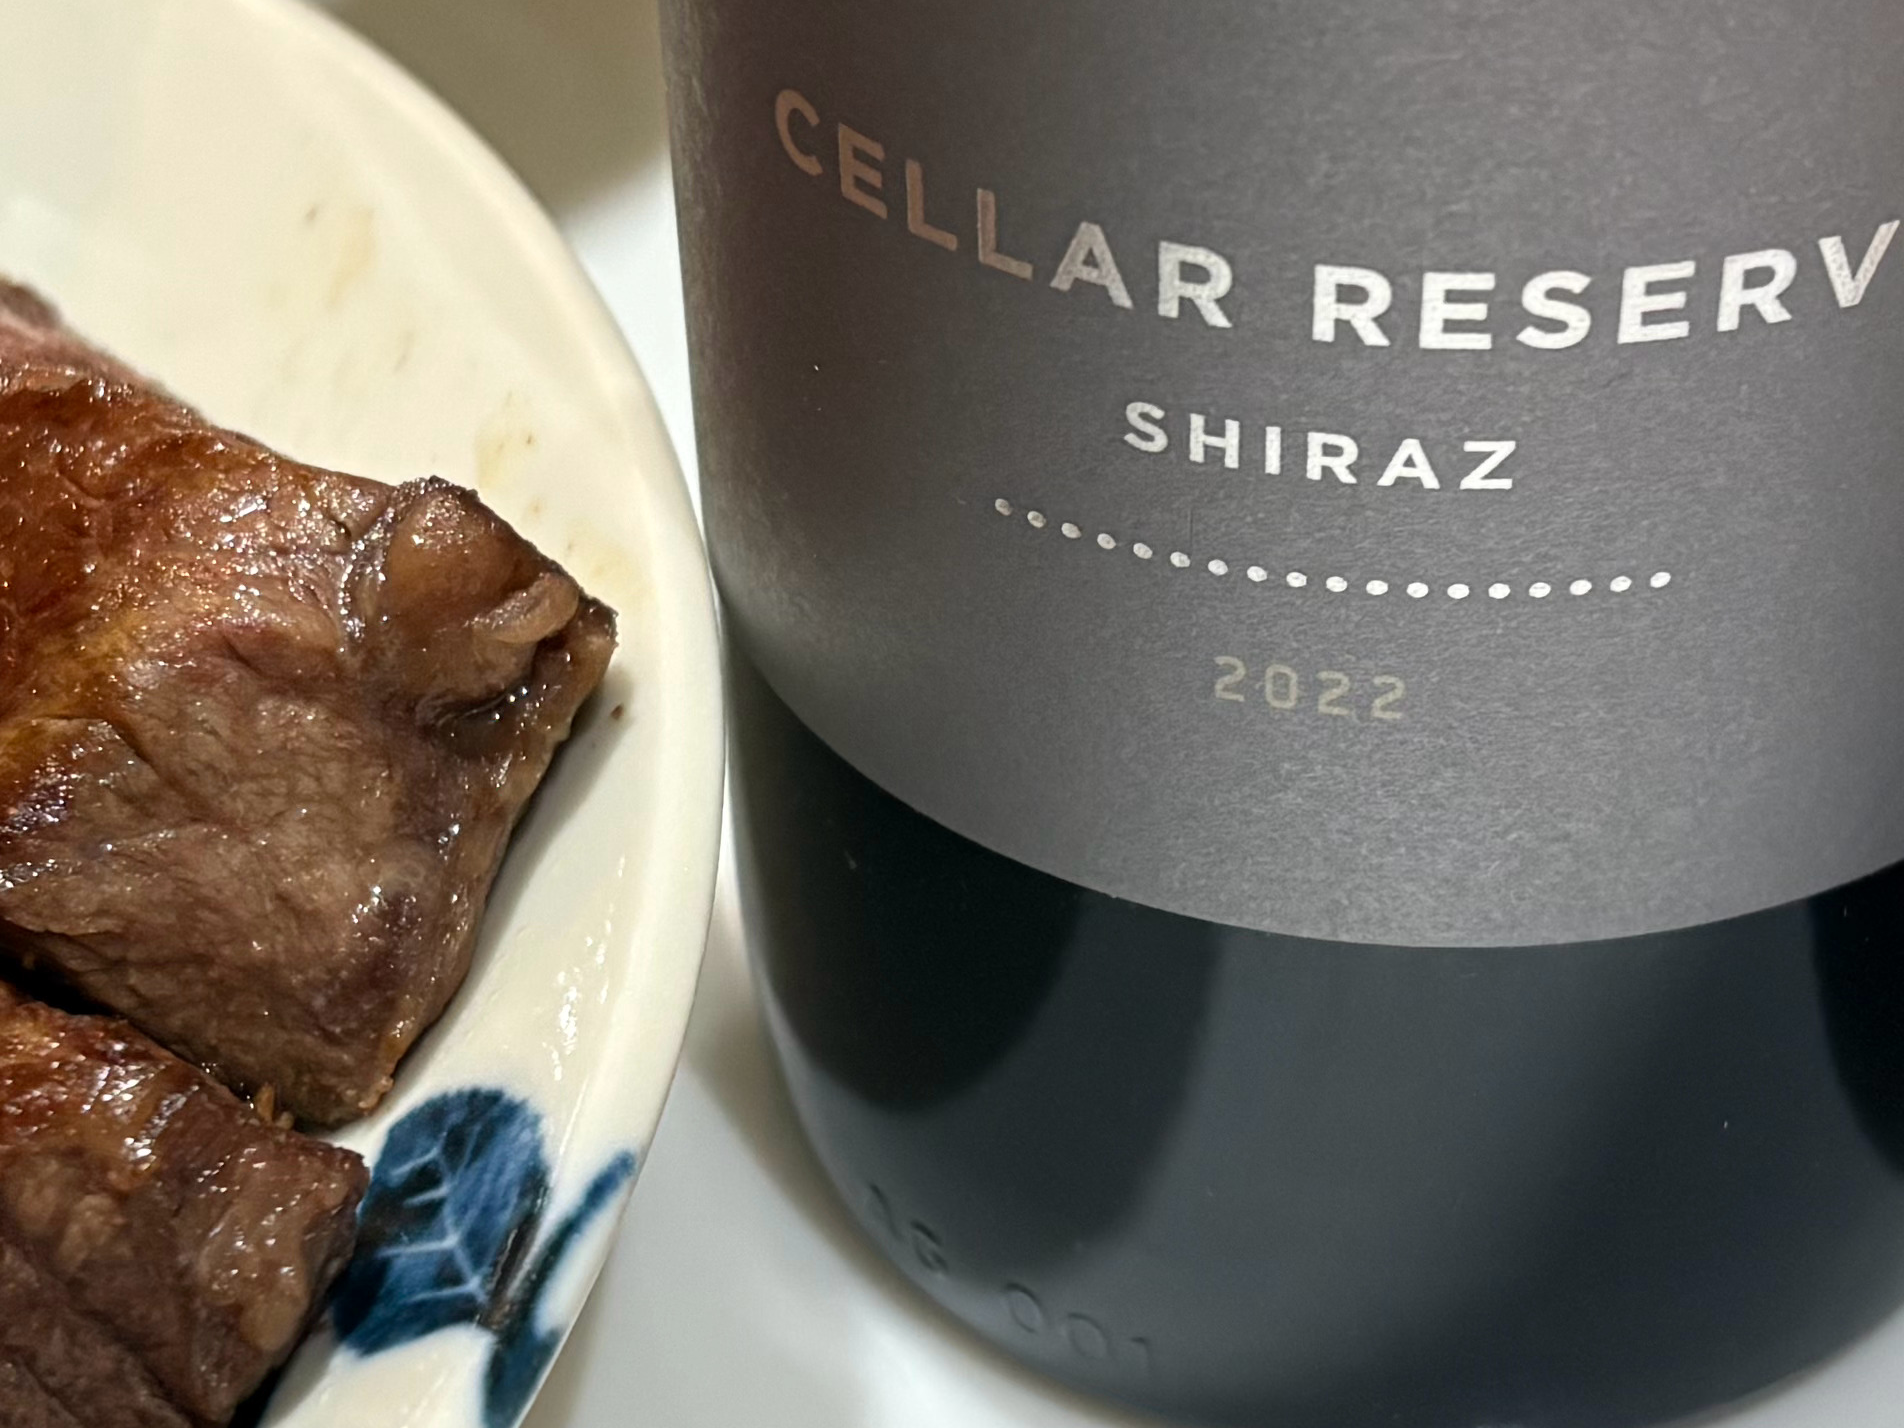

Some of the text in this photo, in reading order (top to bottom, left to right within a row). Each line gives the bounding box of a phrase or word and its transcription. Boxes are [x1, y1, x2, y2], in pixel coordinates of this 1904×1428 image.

[773, 87, 1236, 330] CELLAR
[1121, 399, 1519, 492] SHIRAZ
[1212, 653, 1409, 722] 2022
